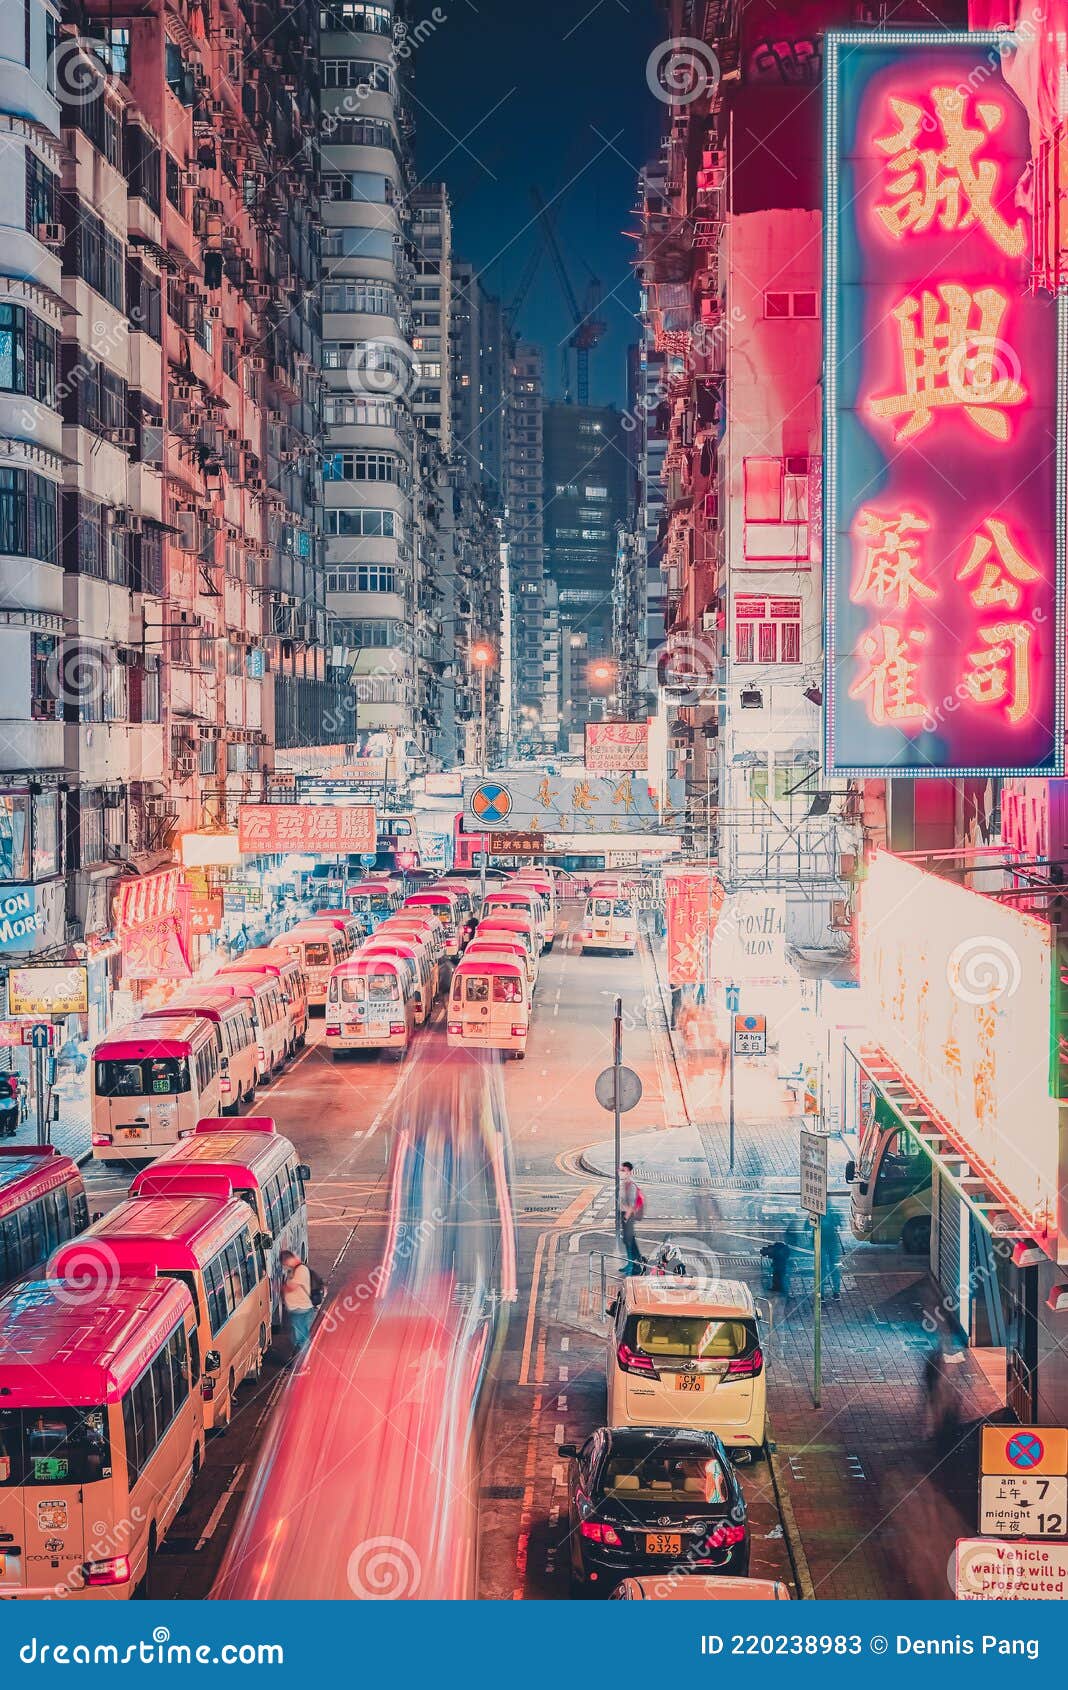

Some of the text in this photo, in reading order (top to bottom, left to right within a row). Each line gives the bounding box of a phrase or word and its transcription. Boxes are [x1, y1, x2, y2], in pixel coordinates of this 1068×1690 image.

[956, 518, 1042, 723] 公司
[741, 1042, 759, 1051] 全日
[679, 1383, 700, 1391] 1970
[996, 1488, 1021, 1499] 上午
[1001, 1478, 1050, 1500] am 7
[985, 1511, 1062, 1533] midnight 12
[995, 1520, 1021, 1532] 午夜
[648, 1544, 679, 1553] 9325
[996, 1548, 1049, 1561] Vehicle
[26, 1554, 83, 1562] COASTER
[972, 1564, 1068, 1577] waiting will b
[982, 1580, 1063, 1592] prosecuted
